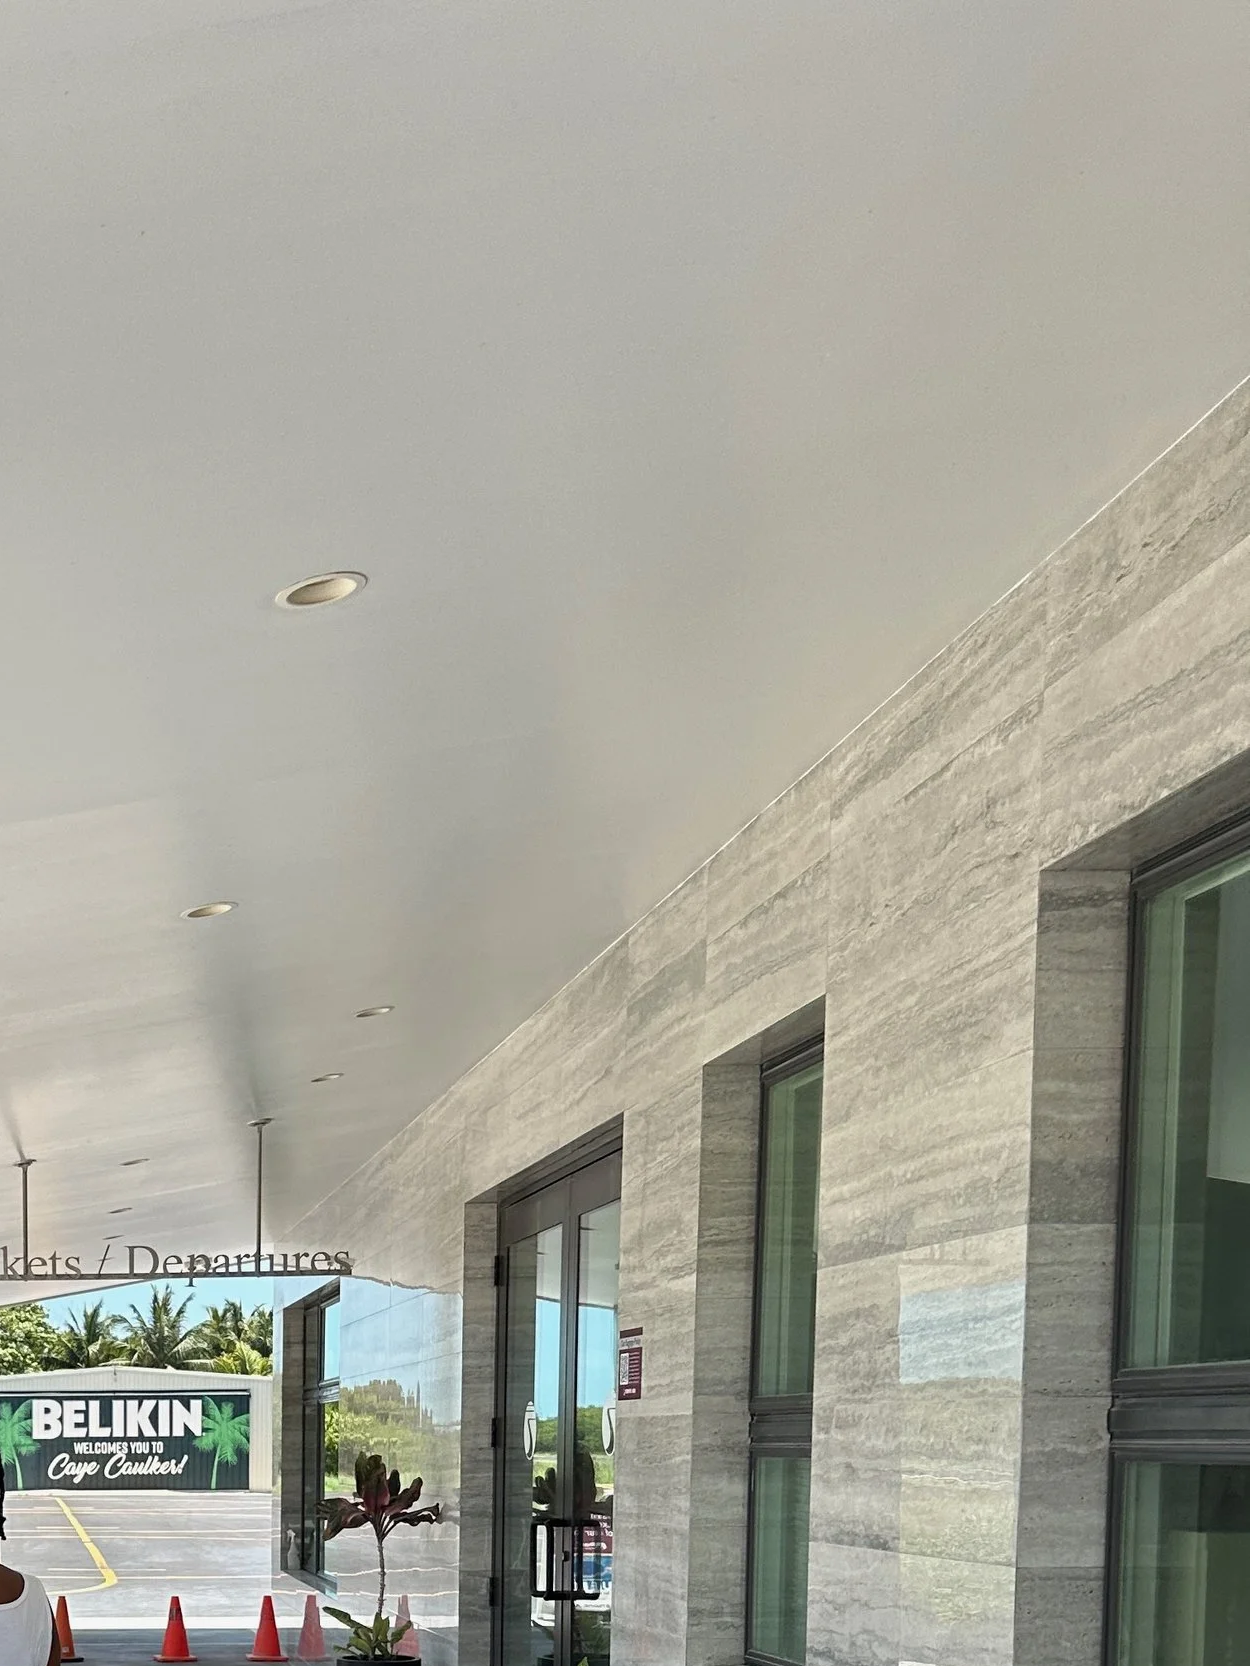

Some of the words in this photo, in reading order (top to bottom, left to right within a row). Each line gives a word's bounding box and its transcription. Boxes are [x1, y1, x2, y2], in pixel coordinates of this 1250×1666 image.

[124, 1245, 352, 1287] Departures
[32, 1399, 203, 1440] BELIKIN
[73, 1441, 129, 1455] WELCOMES
[129, 1441, 150, 1454] YOU
[151, 1441, 164, 1454] TO
[47, 1453, 100, 1484] Caye
[103, 1453, 189, 1479] Caulker!
